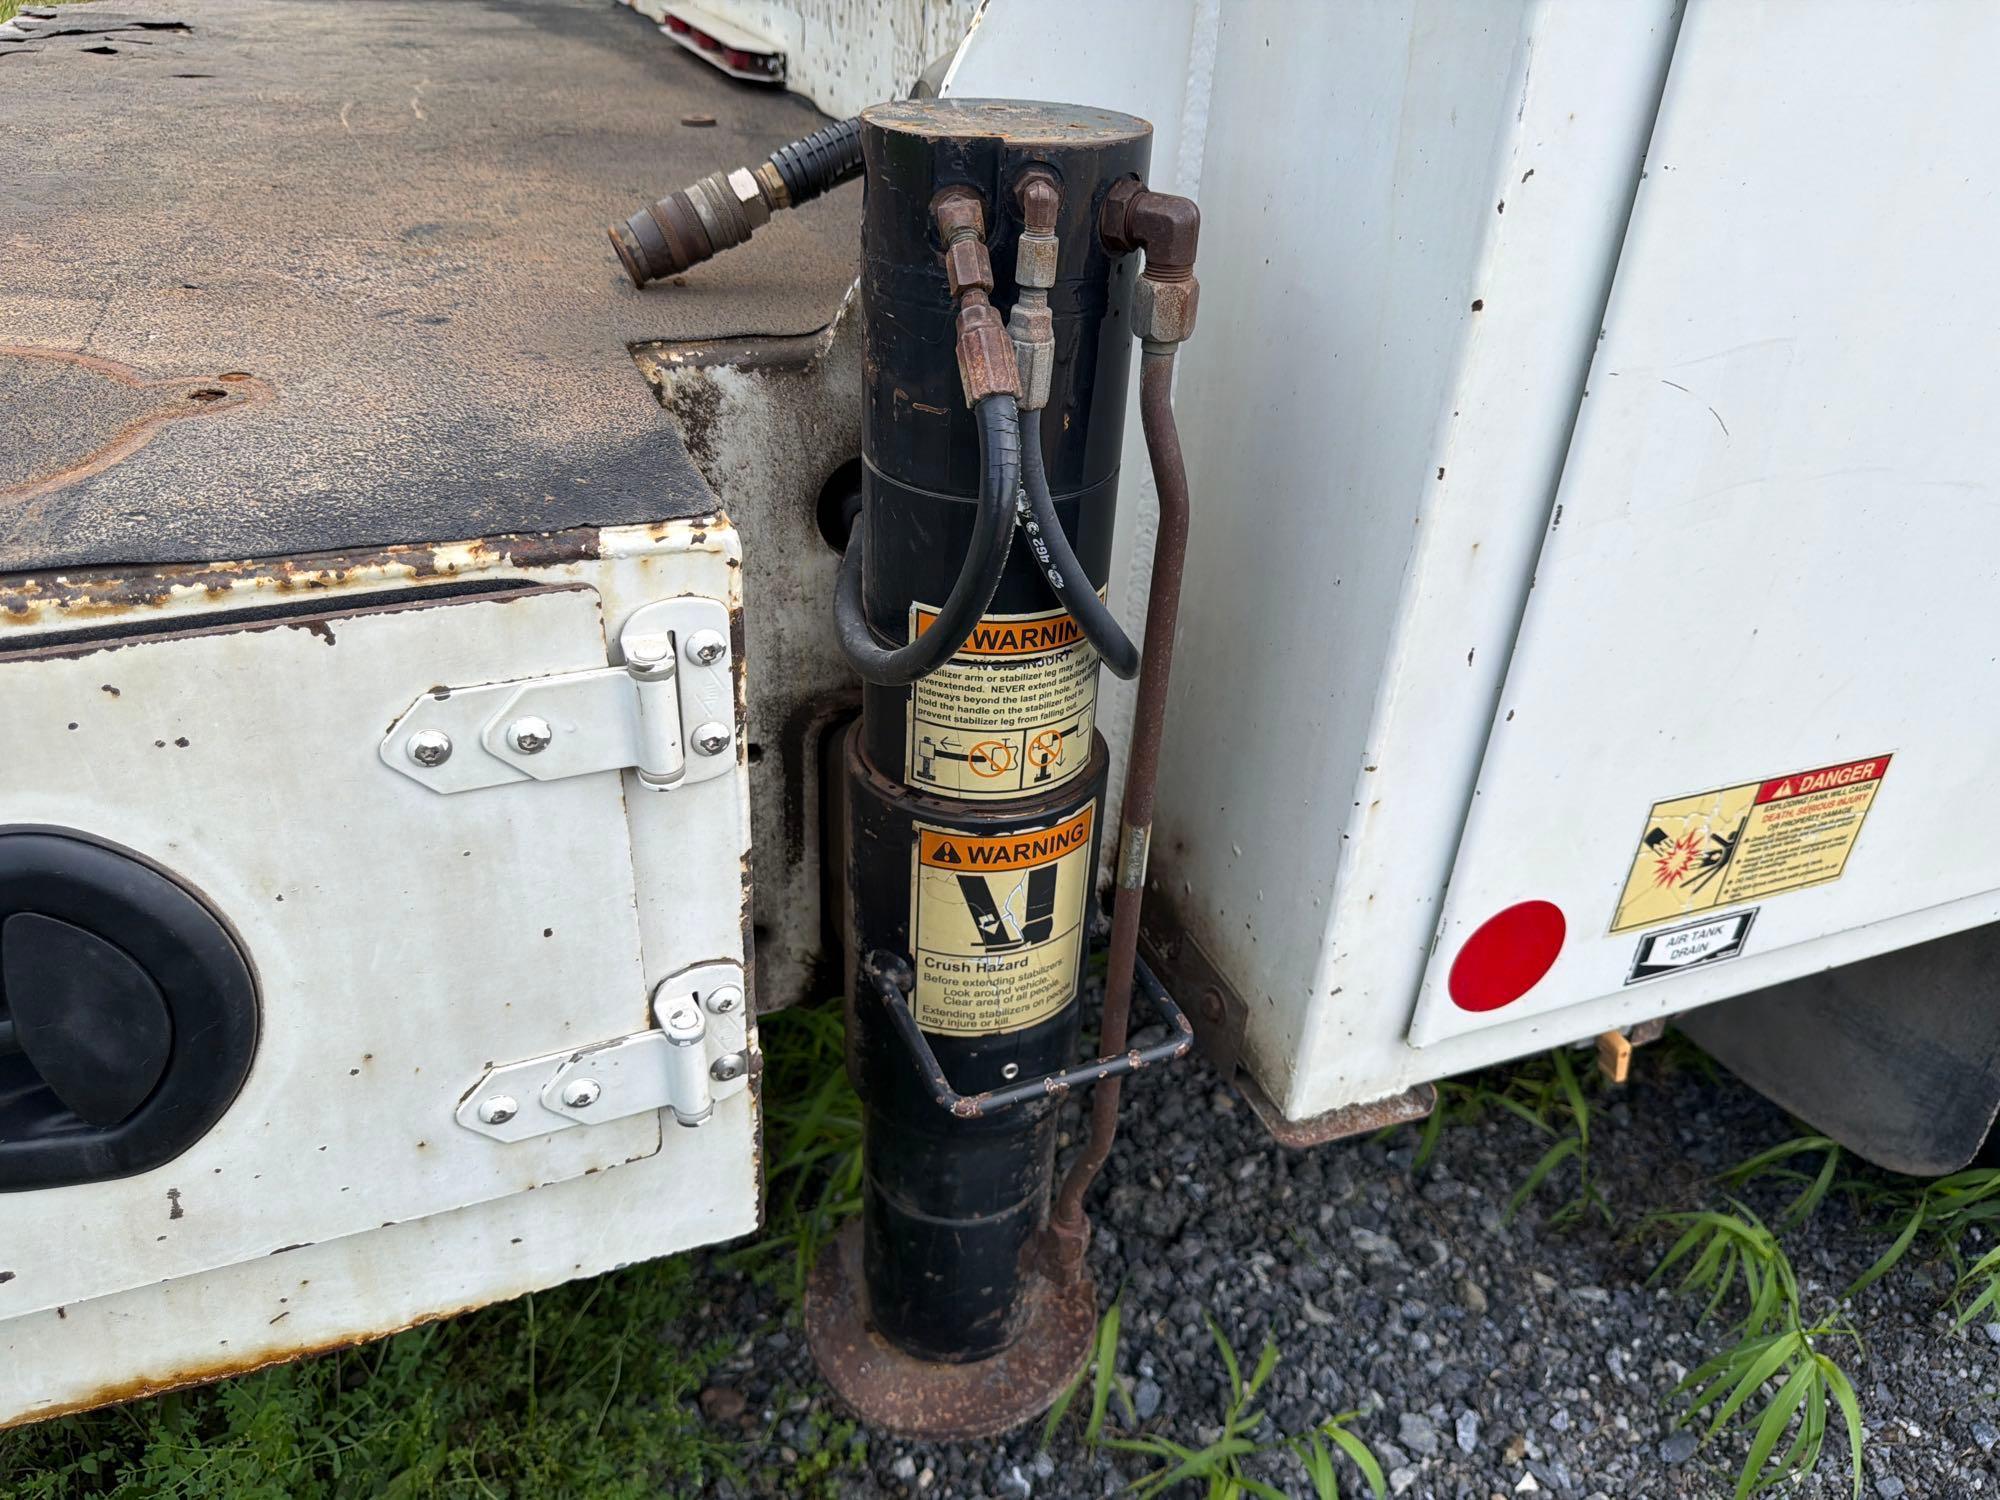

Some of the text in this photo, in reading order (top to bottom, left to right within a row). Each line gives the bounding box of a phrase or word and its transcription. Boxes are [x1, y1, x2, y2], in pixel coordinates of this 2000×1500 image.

[973, 621, 1078, 650] WARNIN
[919, 678, 985, 694] overextended.
[991, 684, 1025, 693] NEVER
[1028, 680, 1057, 691] extend
[1058, 665, 1087, 684] stabilizer
[933, 668, 962, 680] bilizer
[964, 673, 984, 681] arm
[986, 675, 997, 683] or
[1000, 671, 1042, 683] stabilizer
[1044, 669, 1057, 678] leg
[1058, 663, 1074, 674] may
[918, 686, 960, 702] sideways
[963, 695, 1001, 705] beyond
[1002, 696, 1018, 704] the
[1020, 693, 1037, 702] last
[1038, 690, 1052, 701] pin
[1054, 685, 1071, 697] hole.
[918, 695, 938, 708] hold
[940, 701, 955, 711] the
[957, 704, 990, 715] handle
[992, 707, 1005, 715] on
[1008, 705, 1023, 714] the
[1025, 698, 1063, 710] stabilizer
[1064, 690, 1077, 702] foot
[917, 707, 952, 722] prevent
[953, 715, 998, 726] stabilizer
[1000, 717, 1015, 726] leg
[1017, 714, 1038, 724] from
[1040, 707, 1065, 721] falling
[1799, 762, 1877, 793] DANGER
[967, 823, 1084, 865] WARNING
[1666, 924, 1726, 948] AIR TANK
[1670, 941, 1710, 960] DRAIN
[924, 956, 1029, 973] Crush Hazard
[923, 972, 959, 986] Before
[962, 976, 1015, 987] extending
[943, 987, 970, 997] Look
[973, 986, 1012, 997] around
[943, 996, 974, 1006] Clear
[975, 999, 1000, 1007] area
[1003, 995, 1013, 1004] of
[1016, 991, 1028, 1001] all
[922, 1004, 976, 1020] Extending
[978, 1004, 1031, 1019] stabilizers
[1032, 999, 1044, 1008] on
[921, 1014, 945, 1026] may
[947, 1018, 978, 1028] injure
